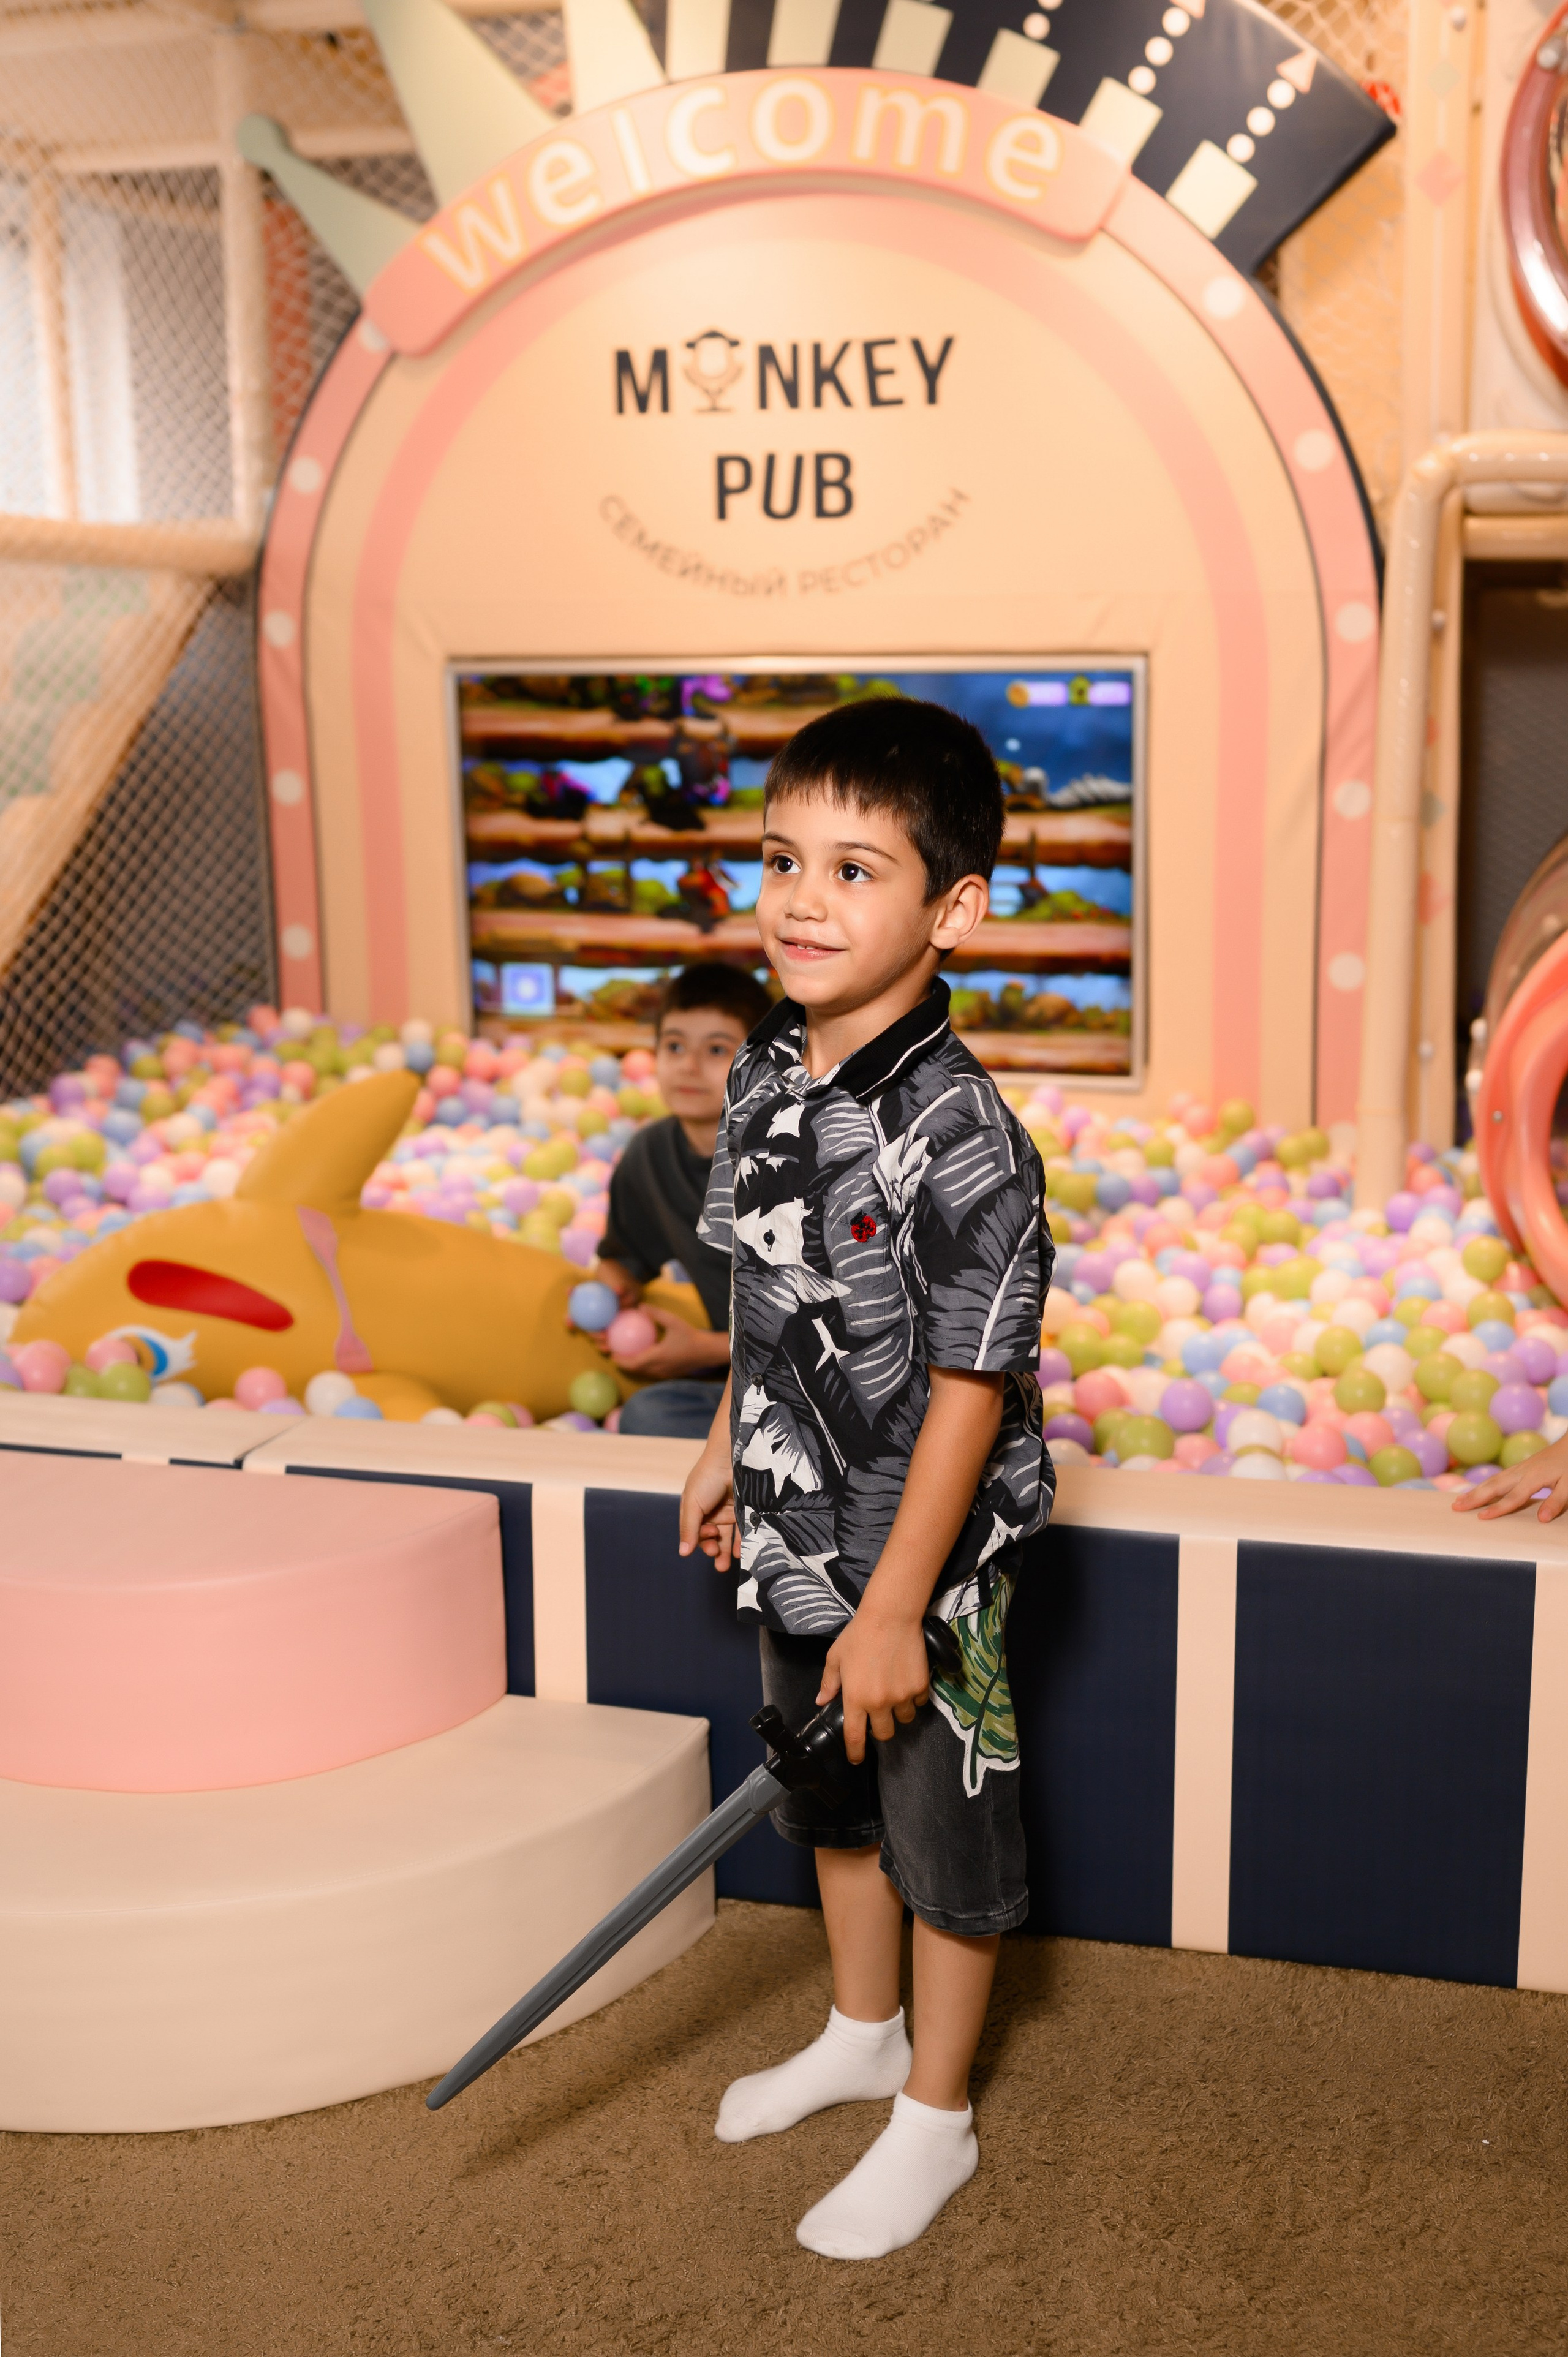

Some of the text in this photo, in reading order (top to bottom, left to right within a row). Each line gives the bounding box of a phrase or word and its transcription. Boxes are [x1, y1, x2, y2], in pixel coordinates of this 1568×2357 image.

[420, 76, 1063, 294] welcome
[716, 452, 854, 521] PUB
[797, 488, 971, 594] РЕСТОРАН
